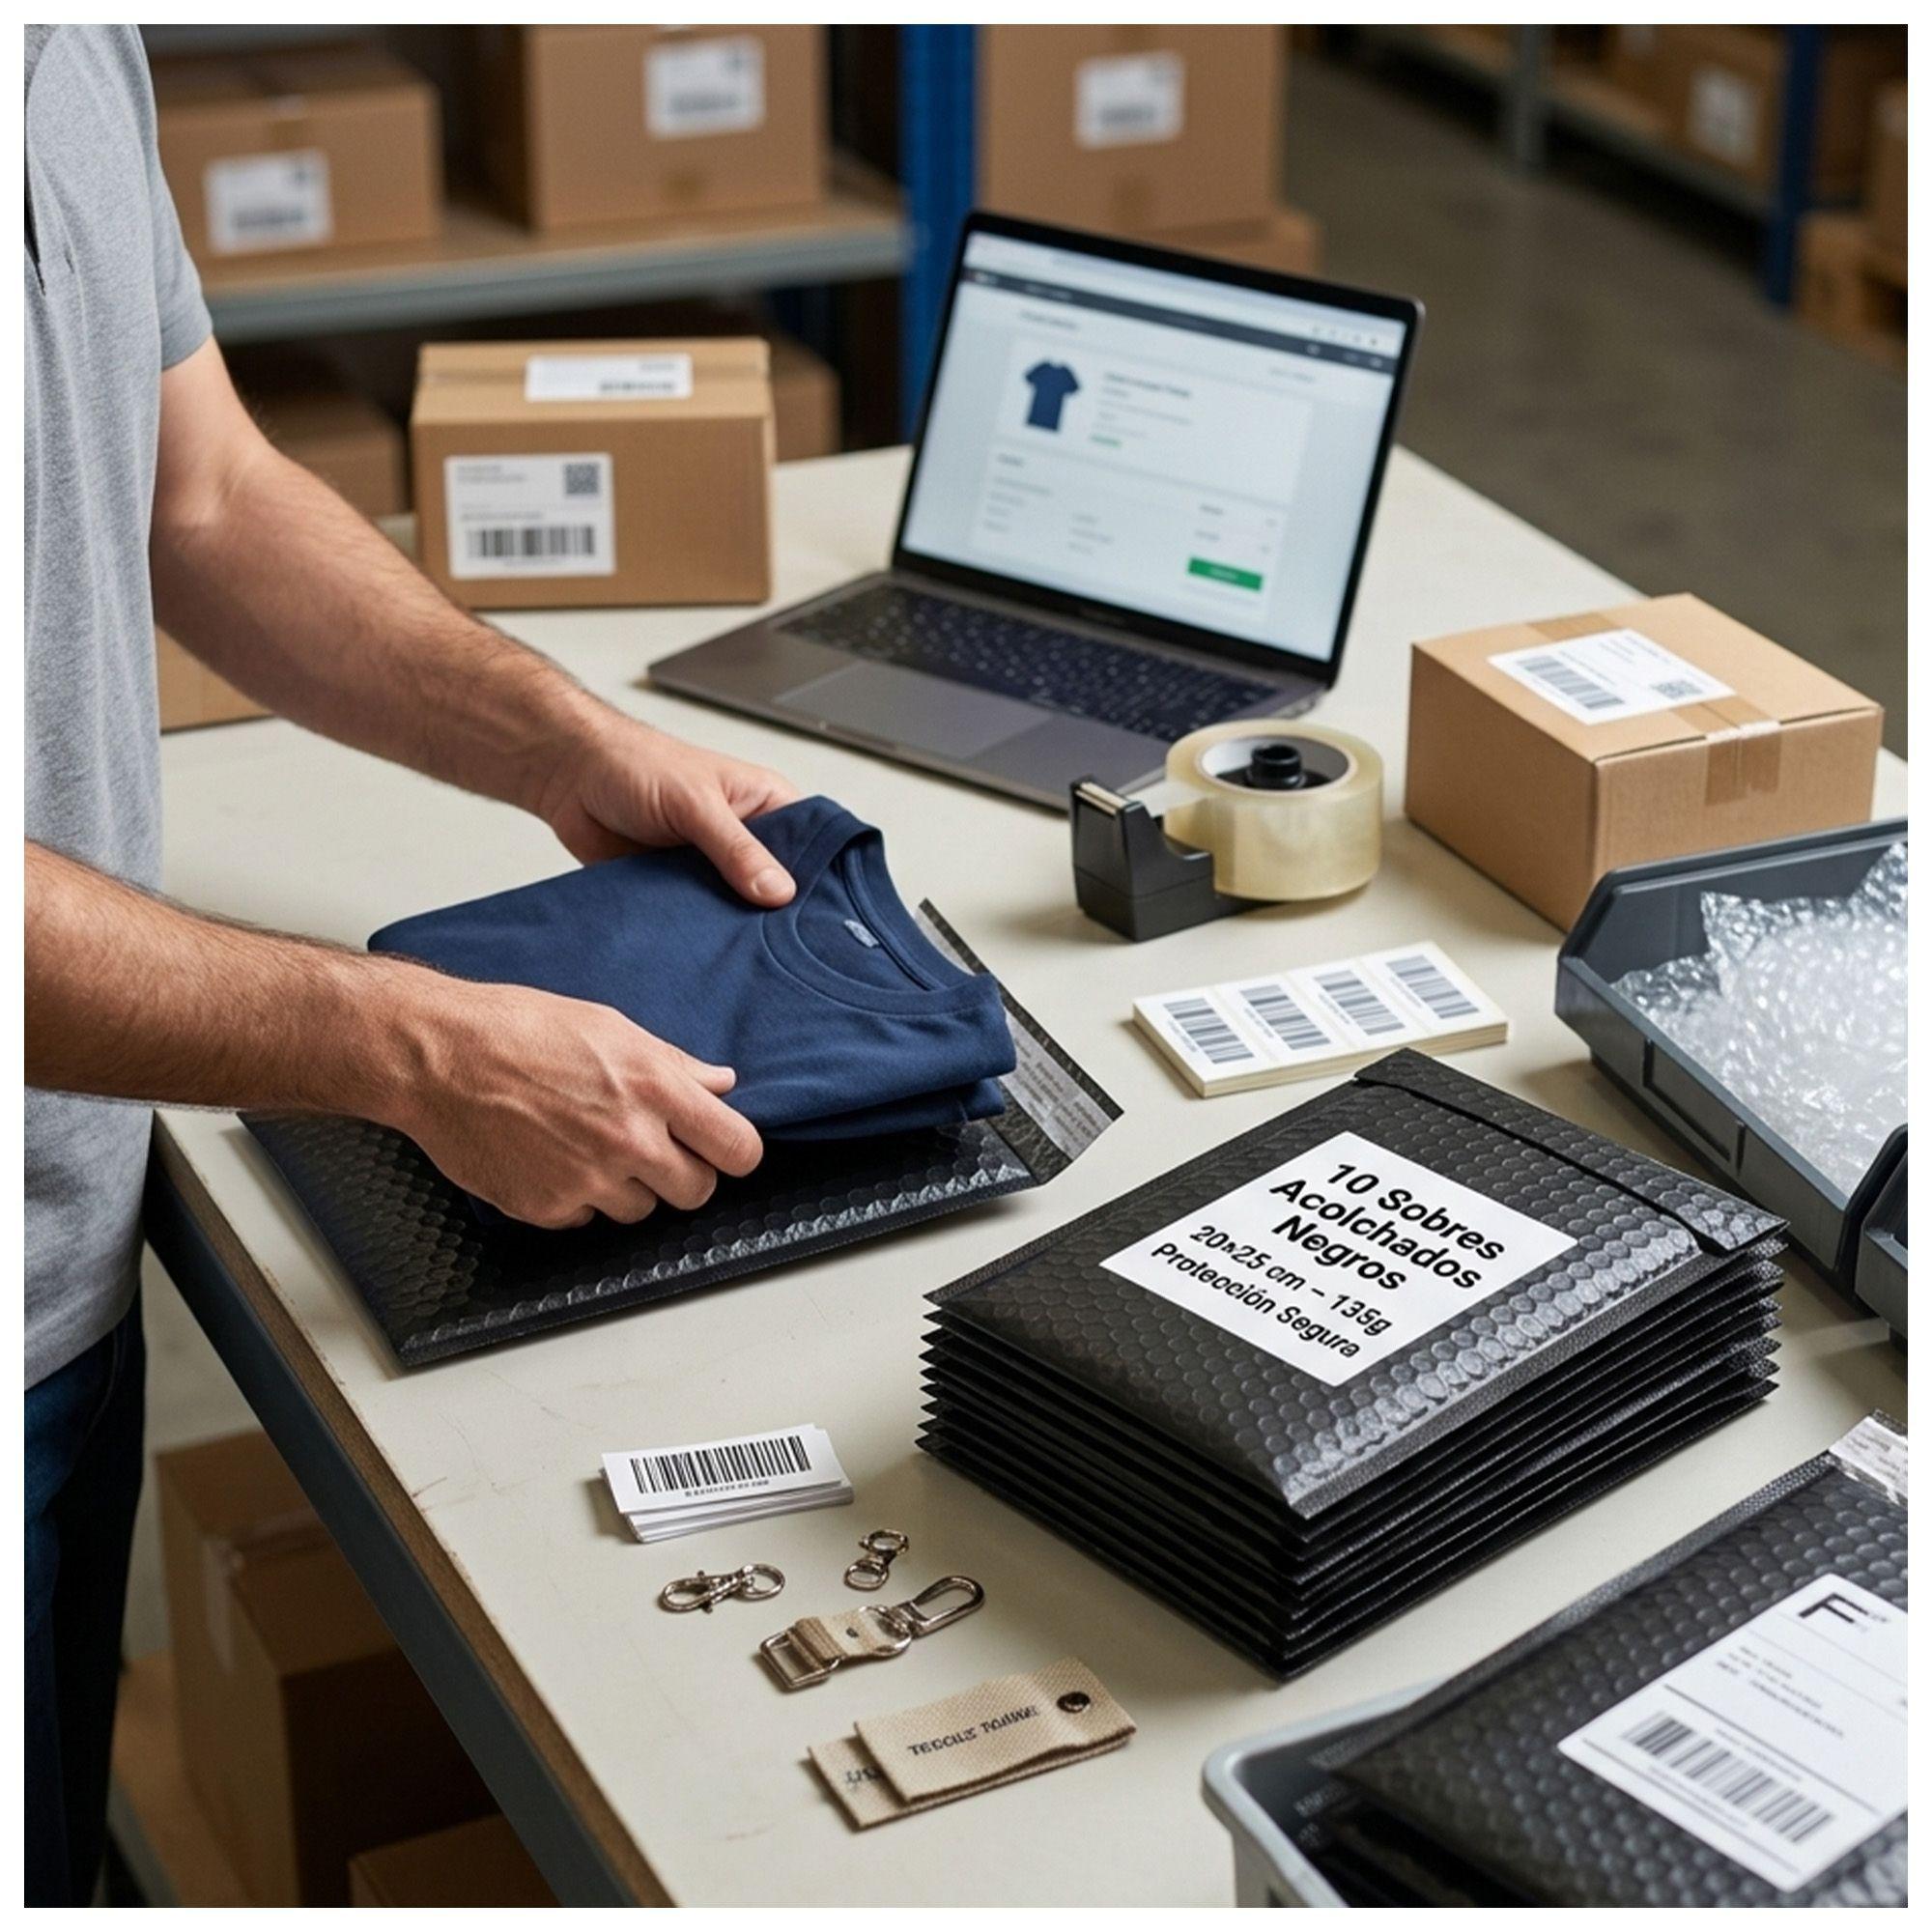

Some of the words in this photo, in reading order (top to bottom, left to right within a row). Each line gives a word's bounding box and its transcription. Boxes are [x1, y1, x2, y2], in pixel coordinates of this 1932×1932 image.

[1268, 1179, 1482, 1289] Acolchados
[1271, 1214, 1406, 1290] Negros
[1327, 1164, 1379, 1195] 10
[1378, 1188, 1505, 1260] Sobres
[1151, 1242, 1276, 1314] Protección
[1276, 1306, 1360, 1358] Segura
[1265, 1265, 1306, 1292] cm
[1330, 1294, 1392, 1337] 135g
